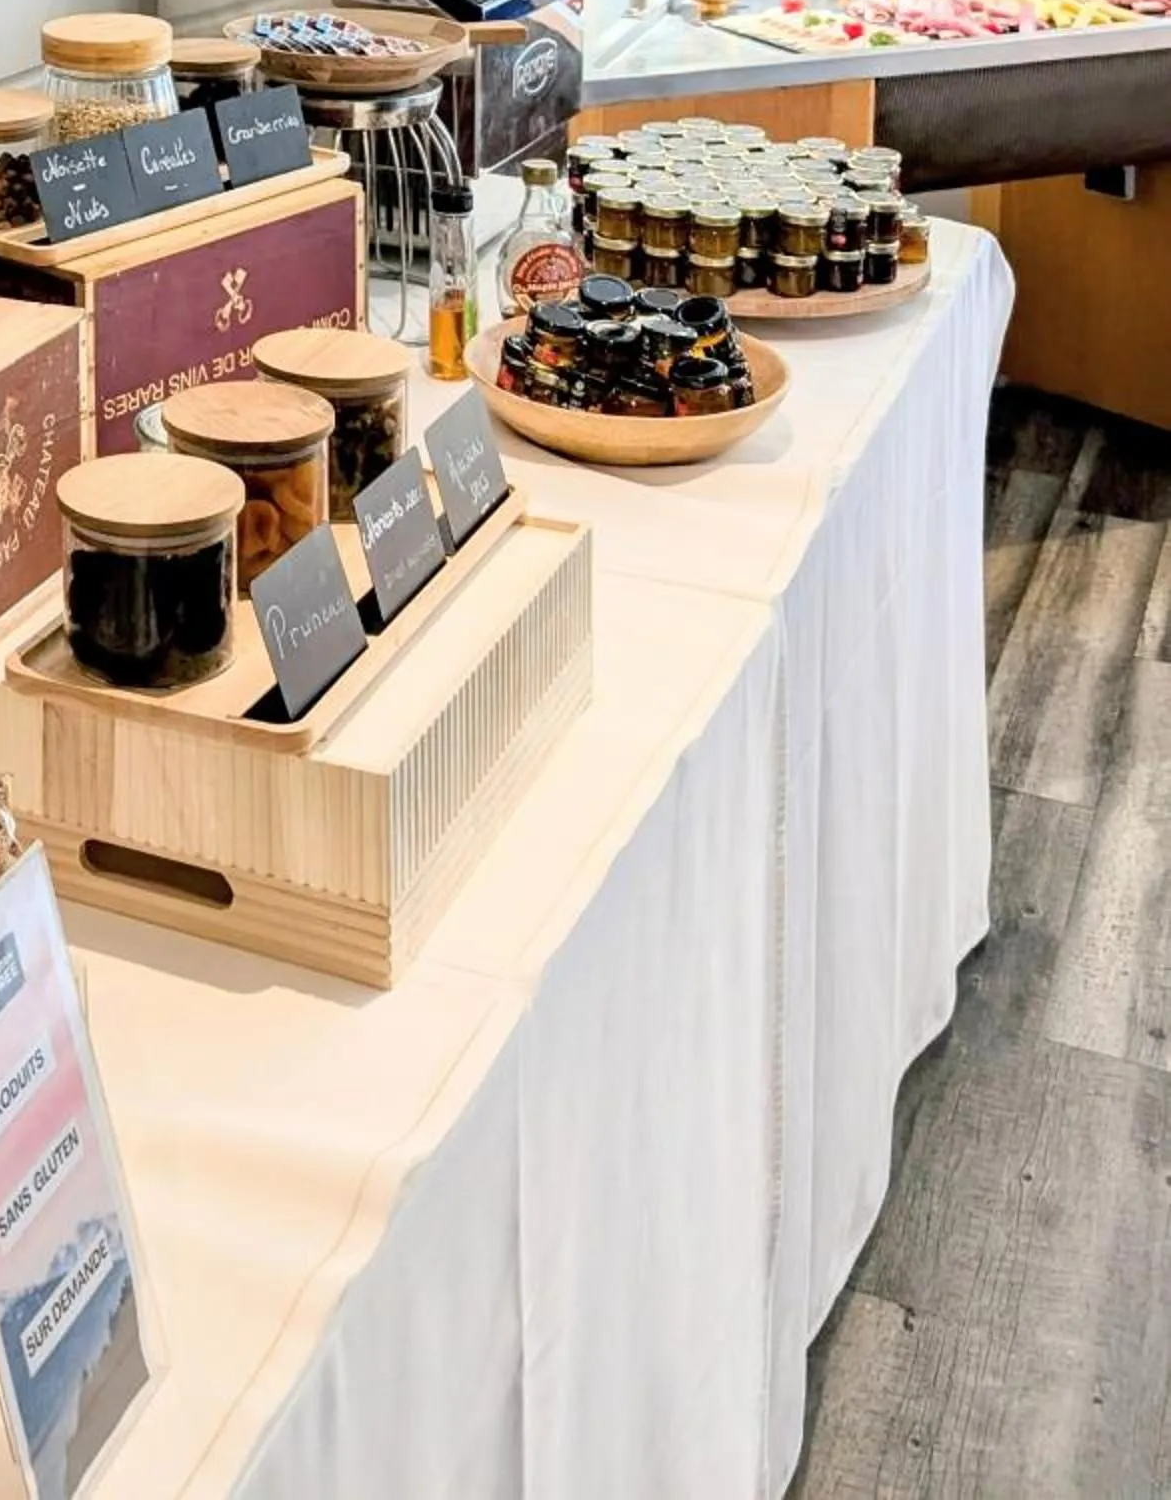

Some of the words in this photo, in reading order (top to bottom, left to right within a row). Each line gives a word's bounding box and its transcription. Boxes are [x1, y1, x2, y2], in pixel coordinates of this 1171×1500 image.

[42, 148, 109, 183] Noisette
[168, 359, 210, 398] VINS
[212, 352, 237, 377] DE
[103, 375, 166, 422] RARES
[32, 1126, 81, 1192] GLUTEN
[24, 1312, 53, 1360] SUR
[51, 1236, 111, 1320] DEMANDE
